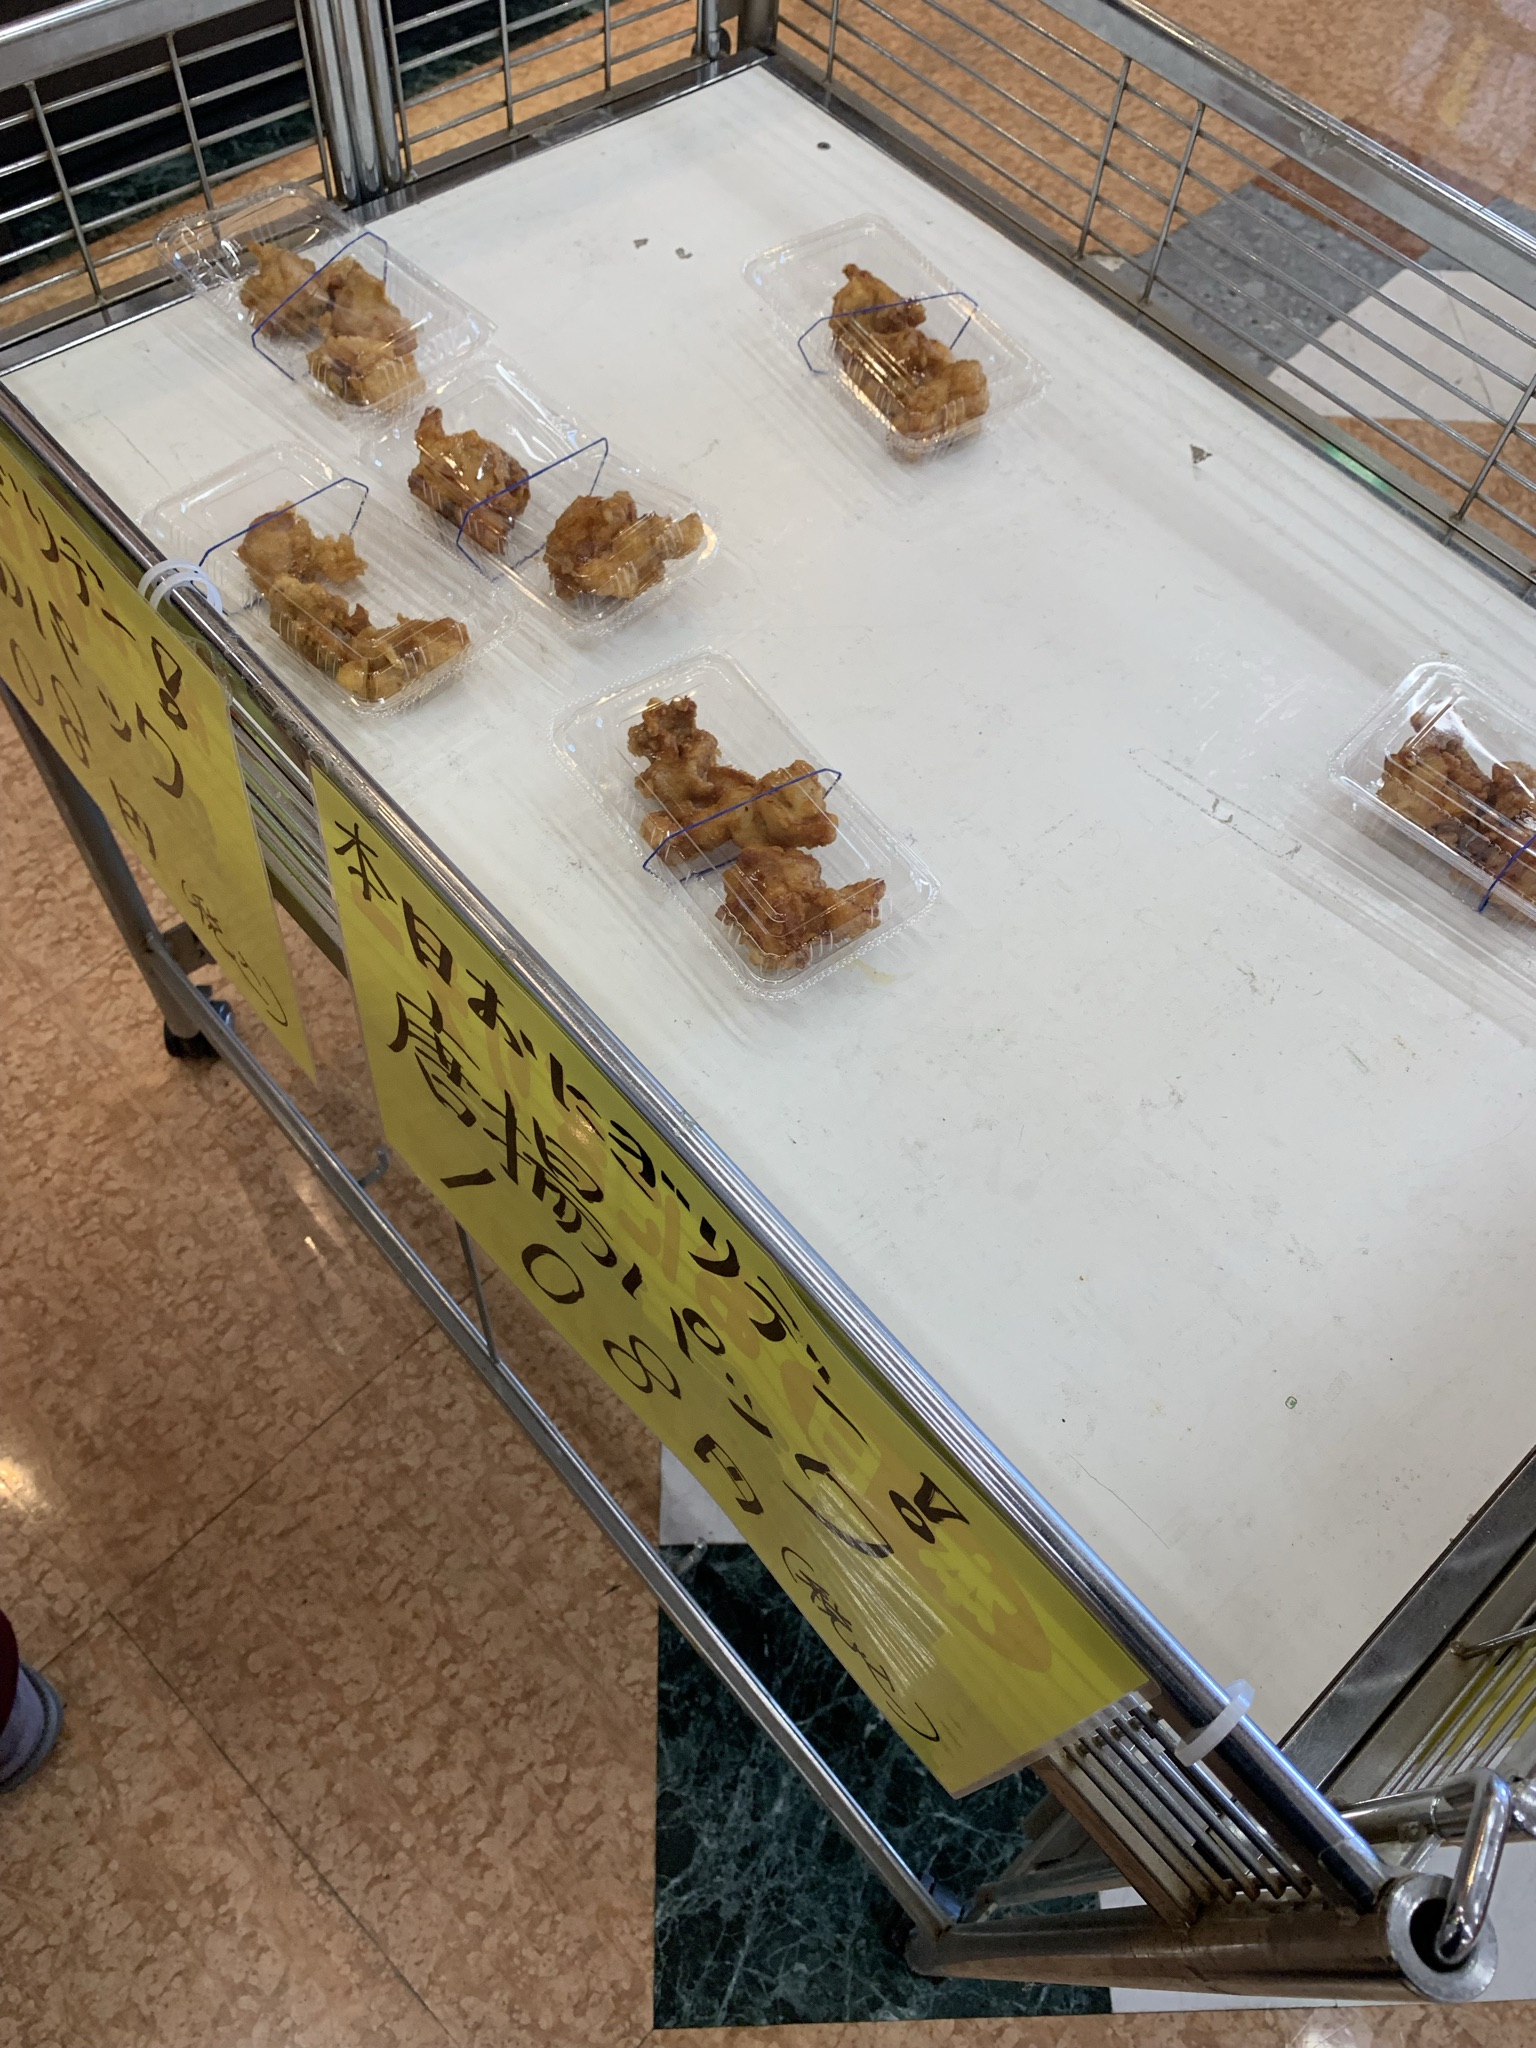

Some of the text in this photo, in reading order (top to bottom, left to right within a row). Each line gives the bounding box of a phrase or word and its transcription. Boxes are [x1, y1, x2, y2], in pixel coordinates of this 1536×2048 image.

[386, 990, 895, 1558] 唐揚パック
[440, 1167, 764, 1516] 108円
